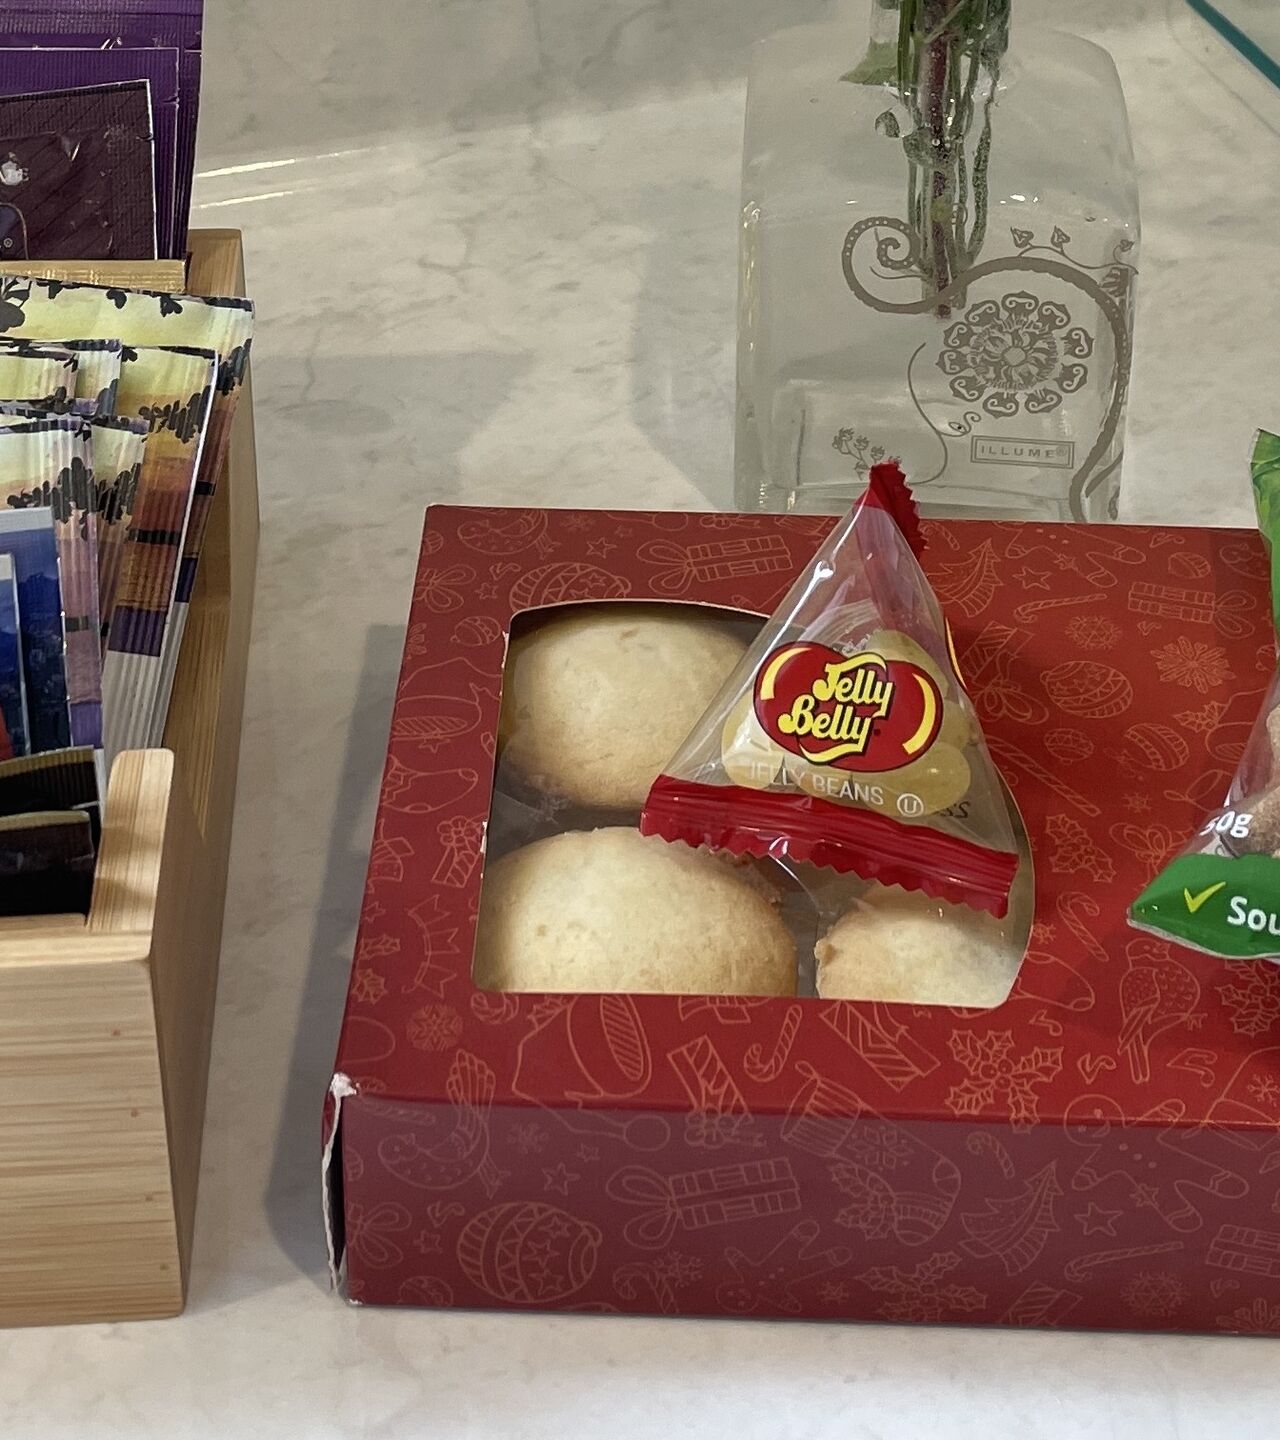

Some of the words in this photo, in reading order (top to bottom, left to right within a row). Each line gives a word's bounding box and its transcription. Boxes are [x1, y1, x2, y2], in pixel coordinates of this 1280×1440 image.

[812, 652, 894, 718] Jelly
[777, 694, 872, 762] Belly
[812, 774, 884, 806] BEANS
